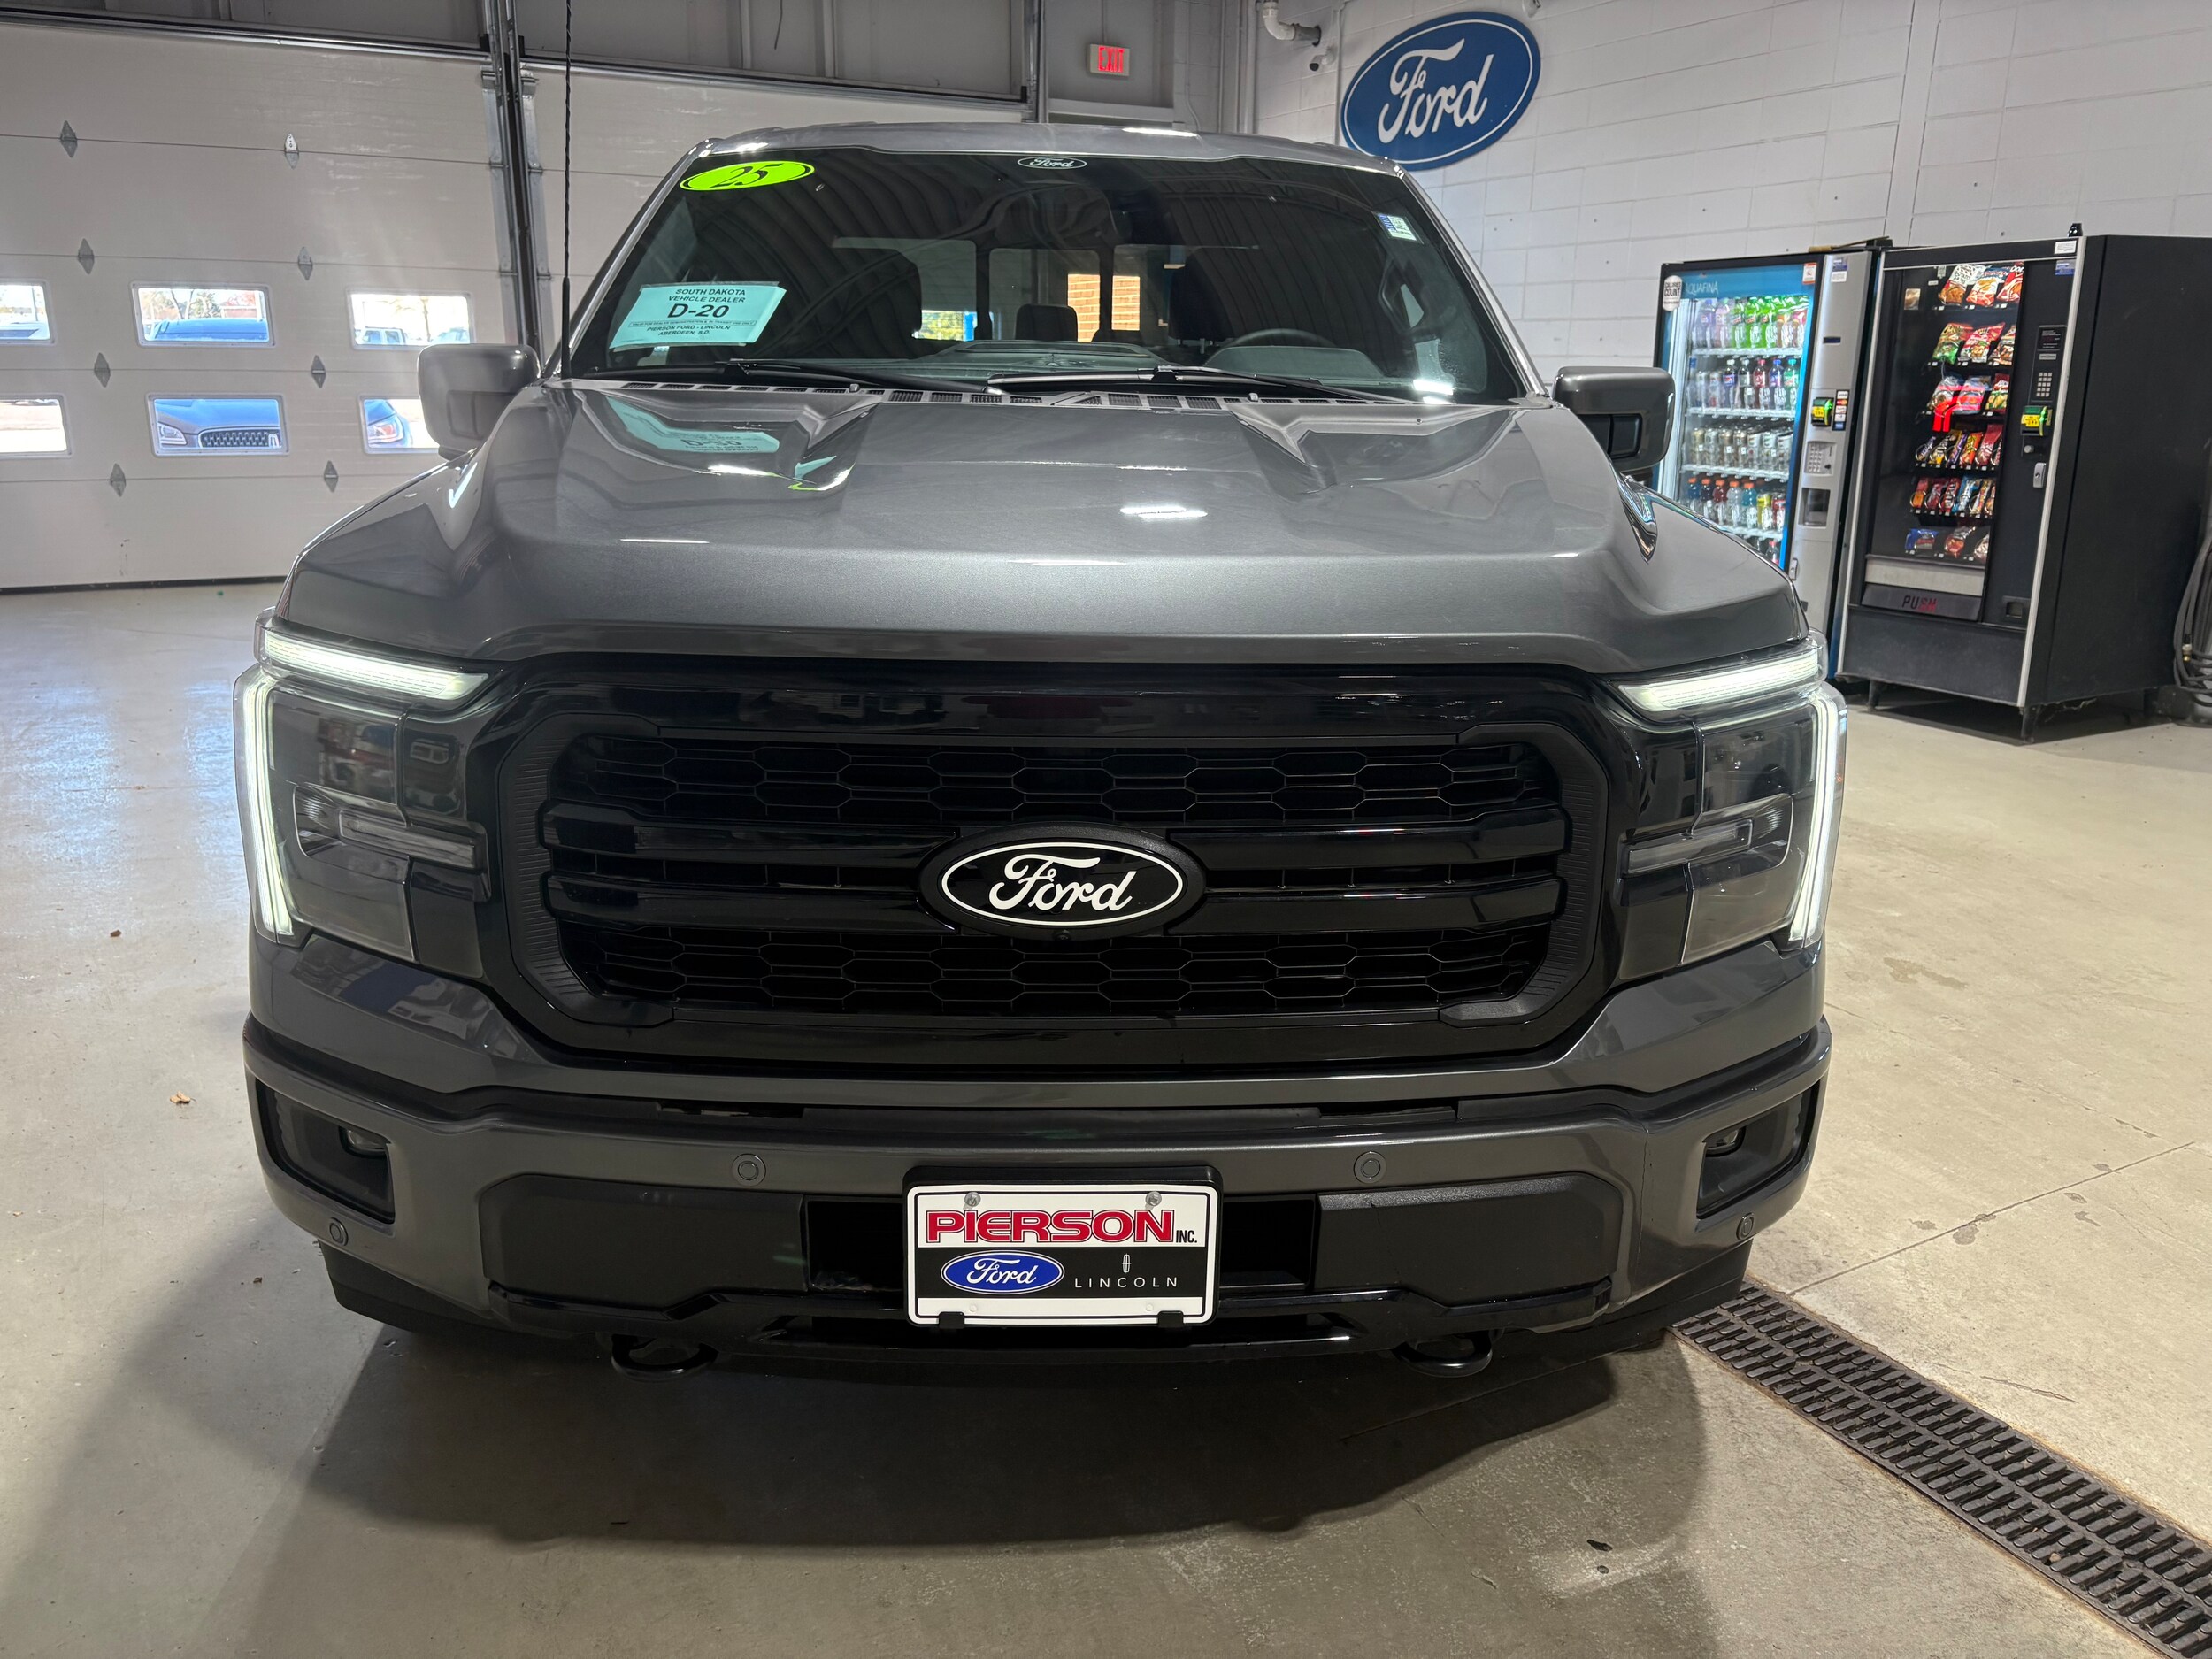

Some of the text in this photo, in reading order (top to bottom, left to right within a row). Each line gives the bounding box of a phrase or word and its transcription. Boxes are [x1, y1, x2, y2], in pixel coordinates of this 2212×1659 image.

[1098, 46, 1125, 73] EXIT
[1378, 38, 1494, 143] Ford
[709, 163, 784, 188] 25
[1030, 157, 1074, 167] Ford
[667, 303, 729, 318] D-20
[1902, 595, 1938, 612] PUSH
[988, 854, 1137, 911] Ford
[926, 1209, 1198, 1244] PIERSON INC.
[966, 1257, 1178, 1288] Ford LINCOLN
